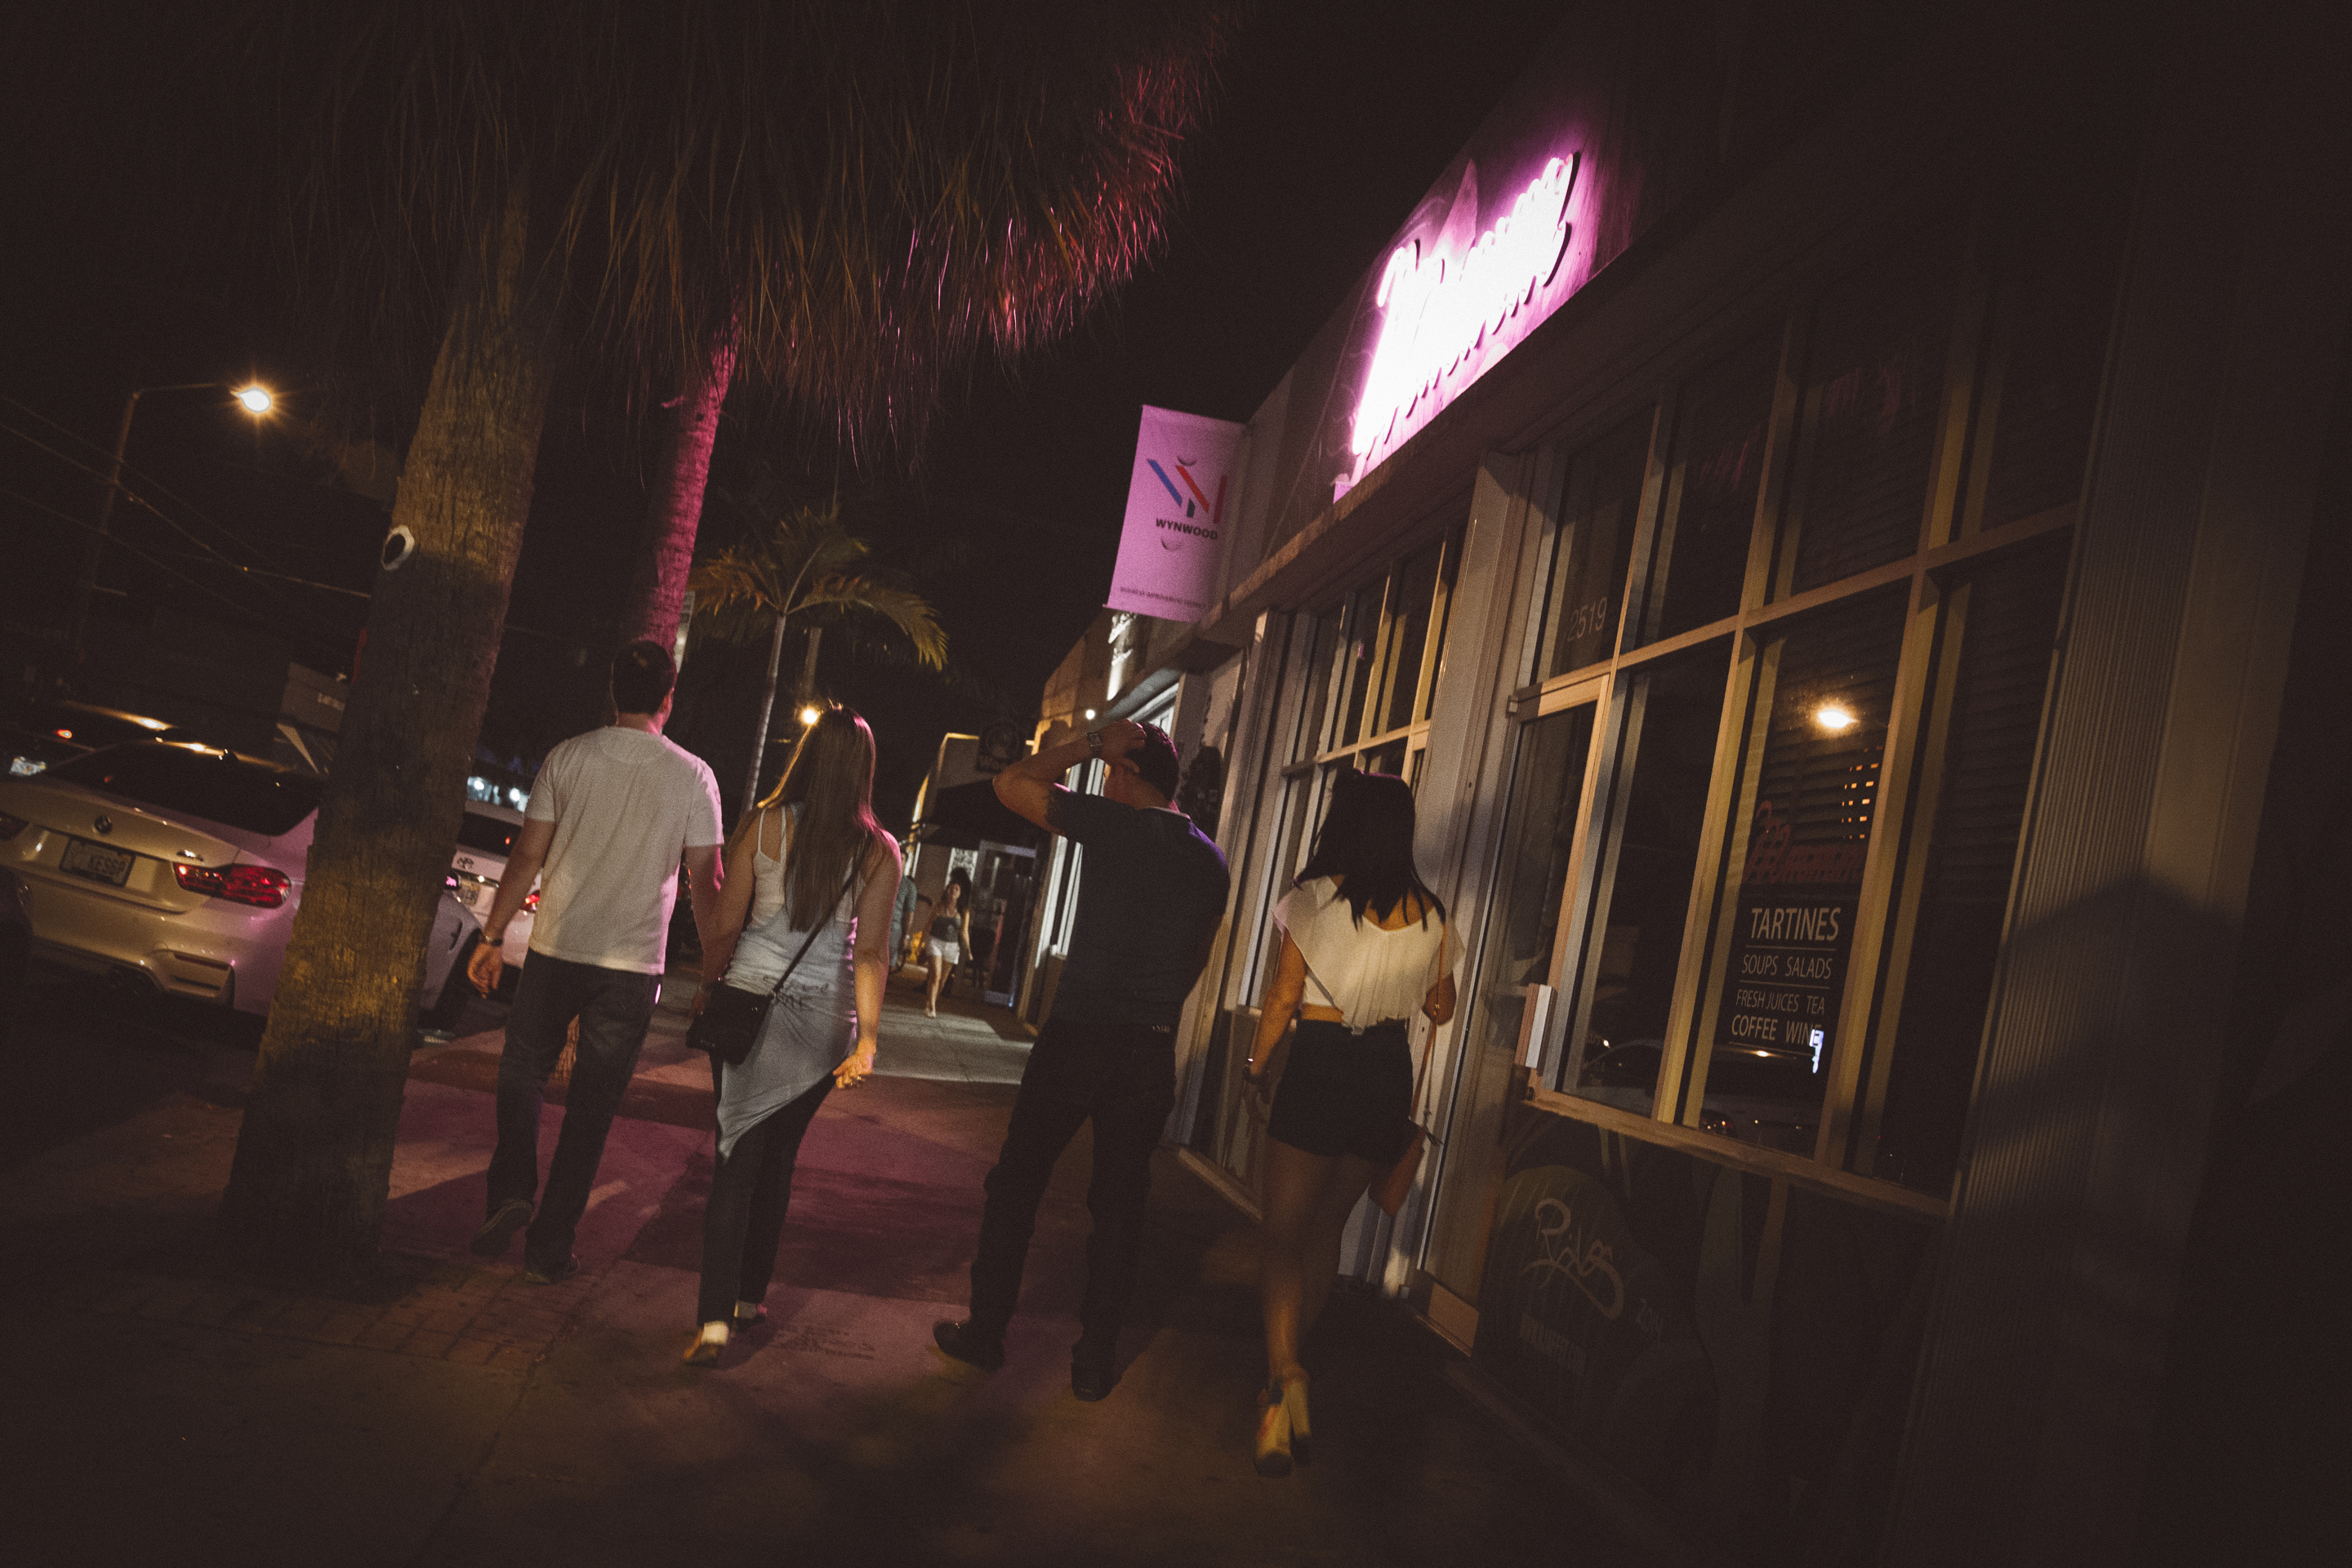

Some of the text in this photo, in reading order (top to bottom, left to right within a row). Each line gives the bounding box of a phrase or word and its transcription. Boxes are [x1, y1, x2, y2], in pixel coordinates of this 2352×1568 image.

[1156, 518, 1218, 541] WYNWOOD
[1567, 596, 1608, 643] 2519
[1751, 906, 1842, 942] TARTINES
[1741, 953, 1833, 980] SOUPS SALADS
[1735, 988, 1826, 1016] FRESH JUICES TEA
[1731, 1013, 1779, 1042] COFFEE
